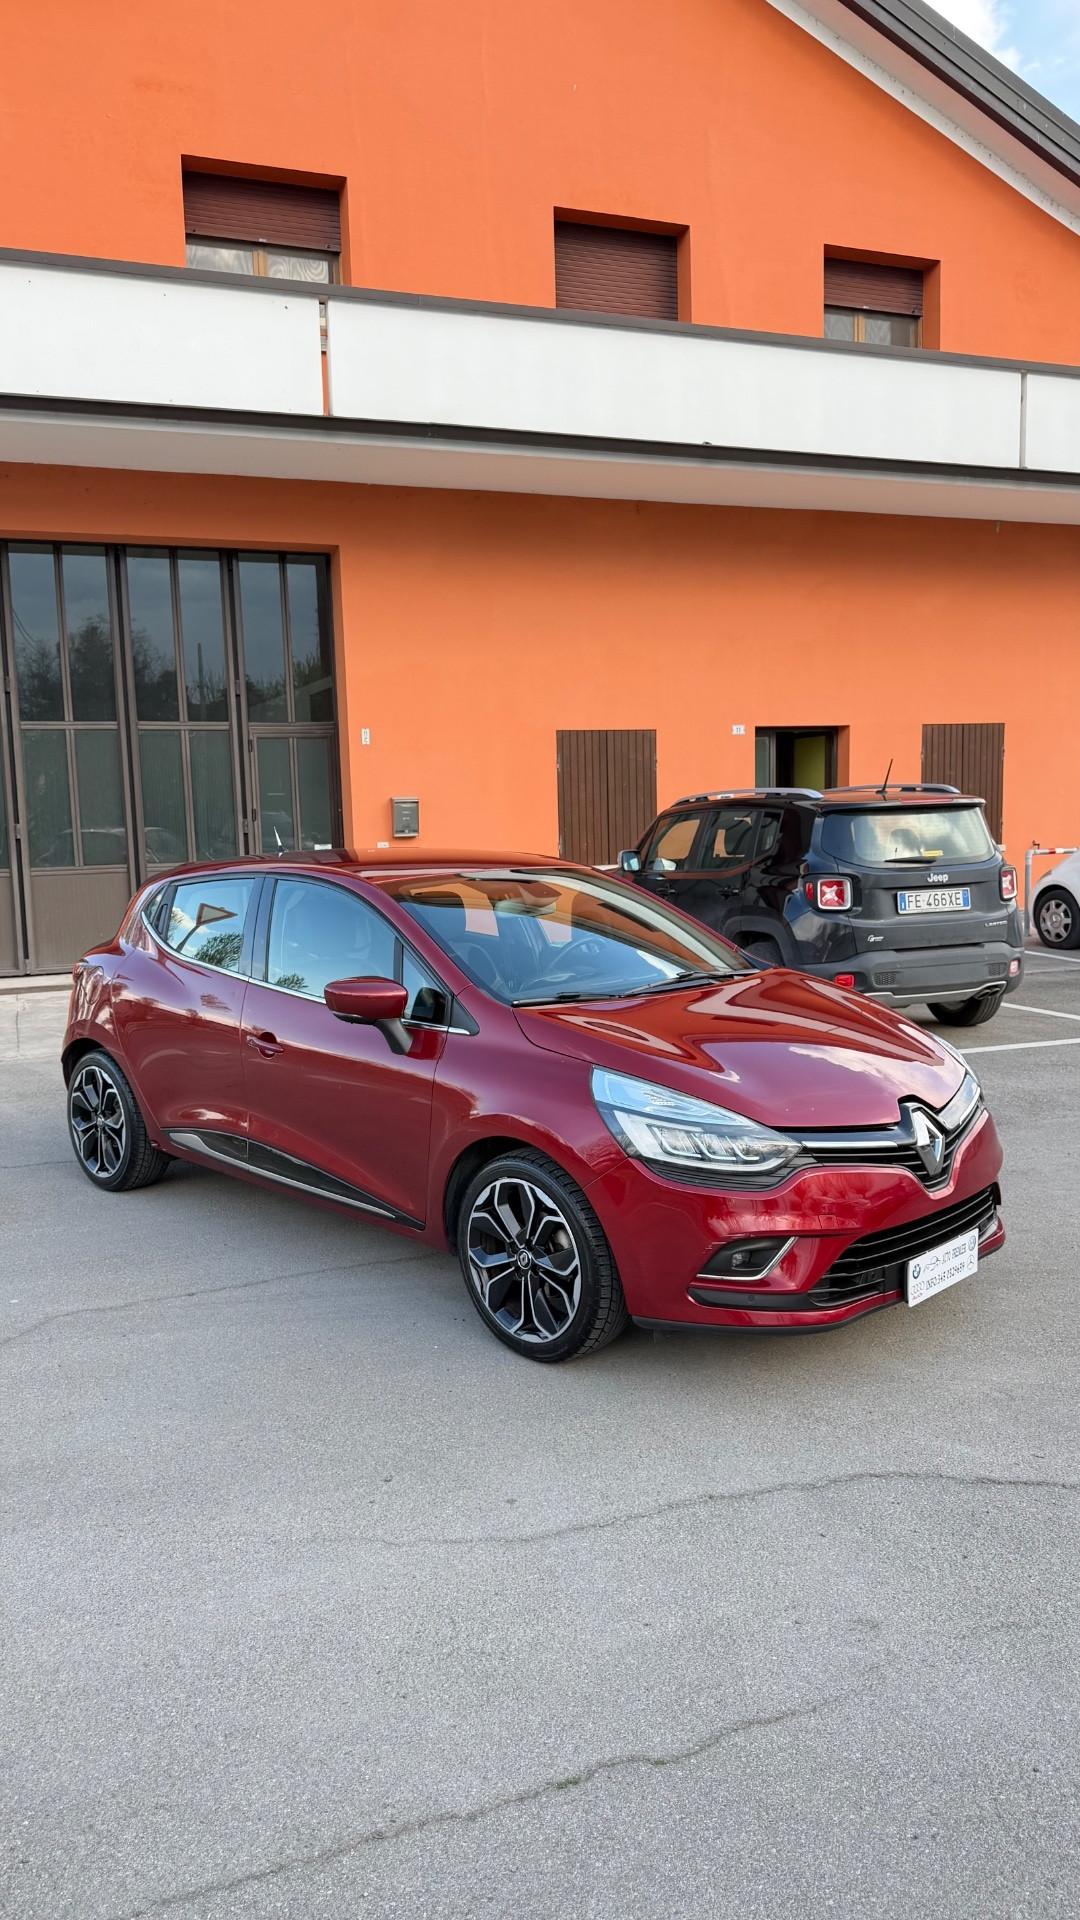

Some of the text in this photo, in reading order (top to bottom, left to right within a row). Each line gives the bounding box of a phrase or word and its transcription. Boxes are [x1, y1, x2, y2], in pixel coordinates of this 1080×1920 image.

[926, 872, 949, 883] Jeep
[907, 892, 962, 909] FE 466XE
